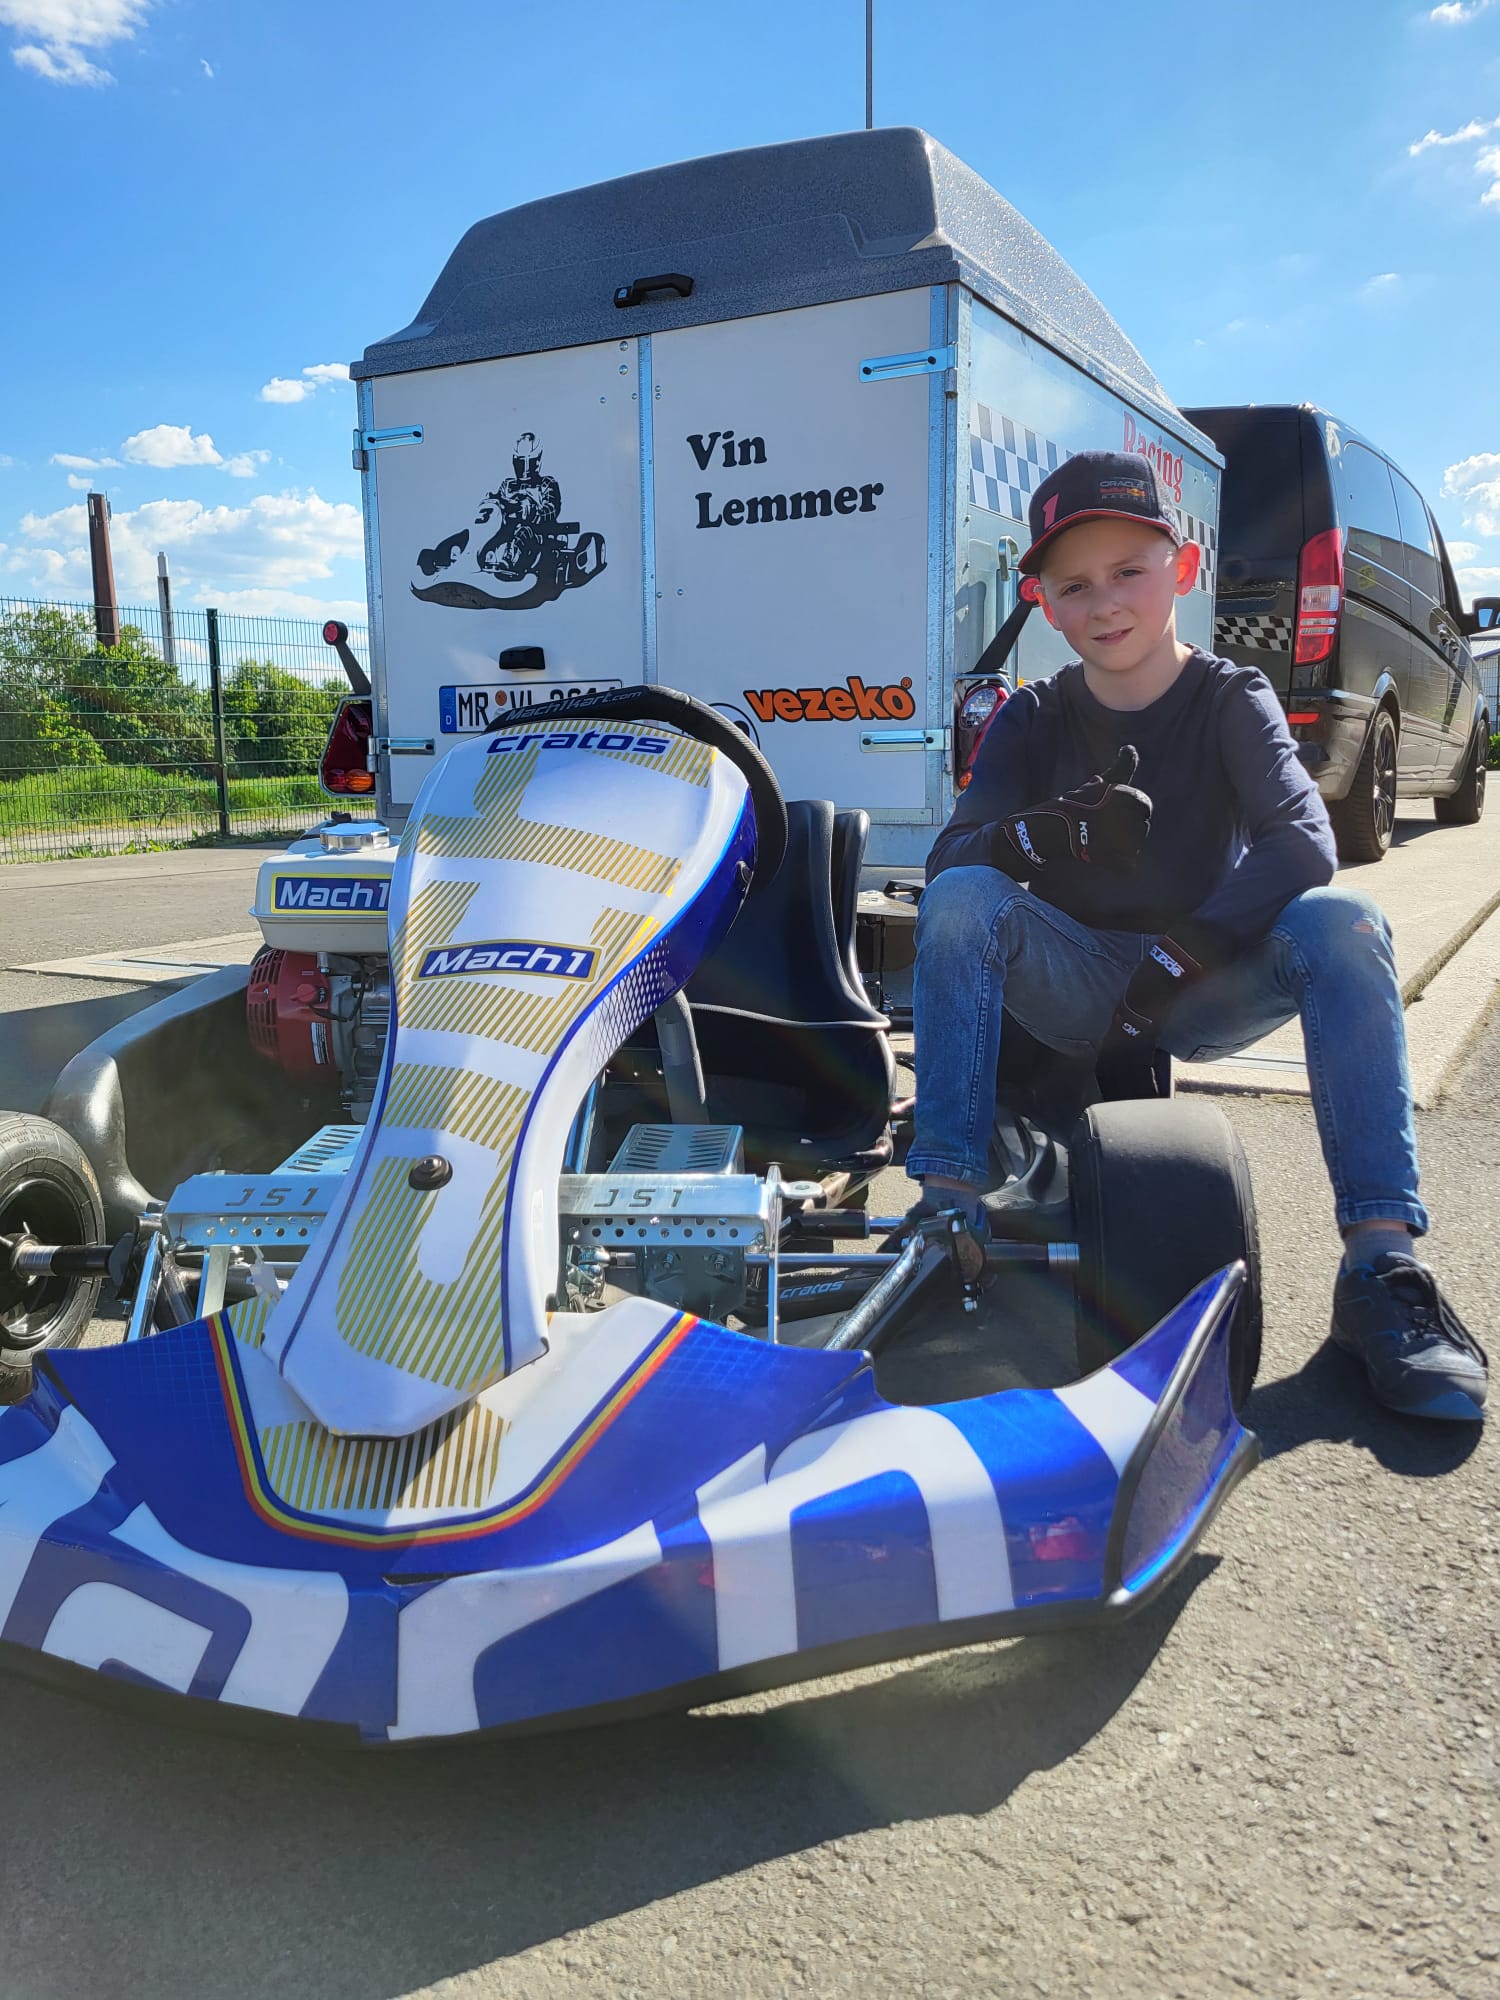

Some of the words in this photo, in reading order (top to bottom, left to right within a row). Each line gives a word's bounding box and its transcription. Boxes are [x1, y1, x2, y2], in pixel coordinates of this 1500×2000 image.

[686, 430, 767, 471] Vin
[1122, 411, 1184, 503] Racing
[695, 482, 885, 529] Lemmer
[1042, 493, 1060, 529] 1
[458, 692, 490, 727] MR
[743, 676, 915, 723] vezeko
[486, 730, 670, 755] cratos
[279, 880, 389, 908] Mach1
[425, 947, 582, 974] Mach1
[225, 1188, 319, 1206] JS1
[593, 1188, 683, 1208] JS1
[780, 1281, 846, 1299] cratos
